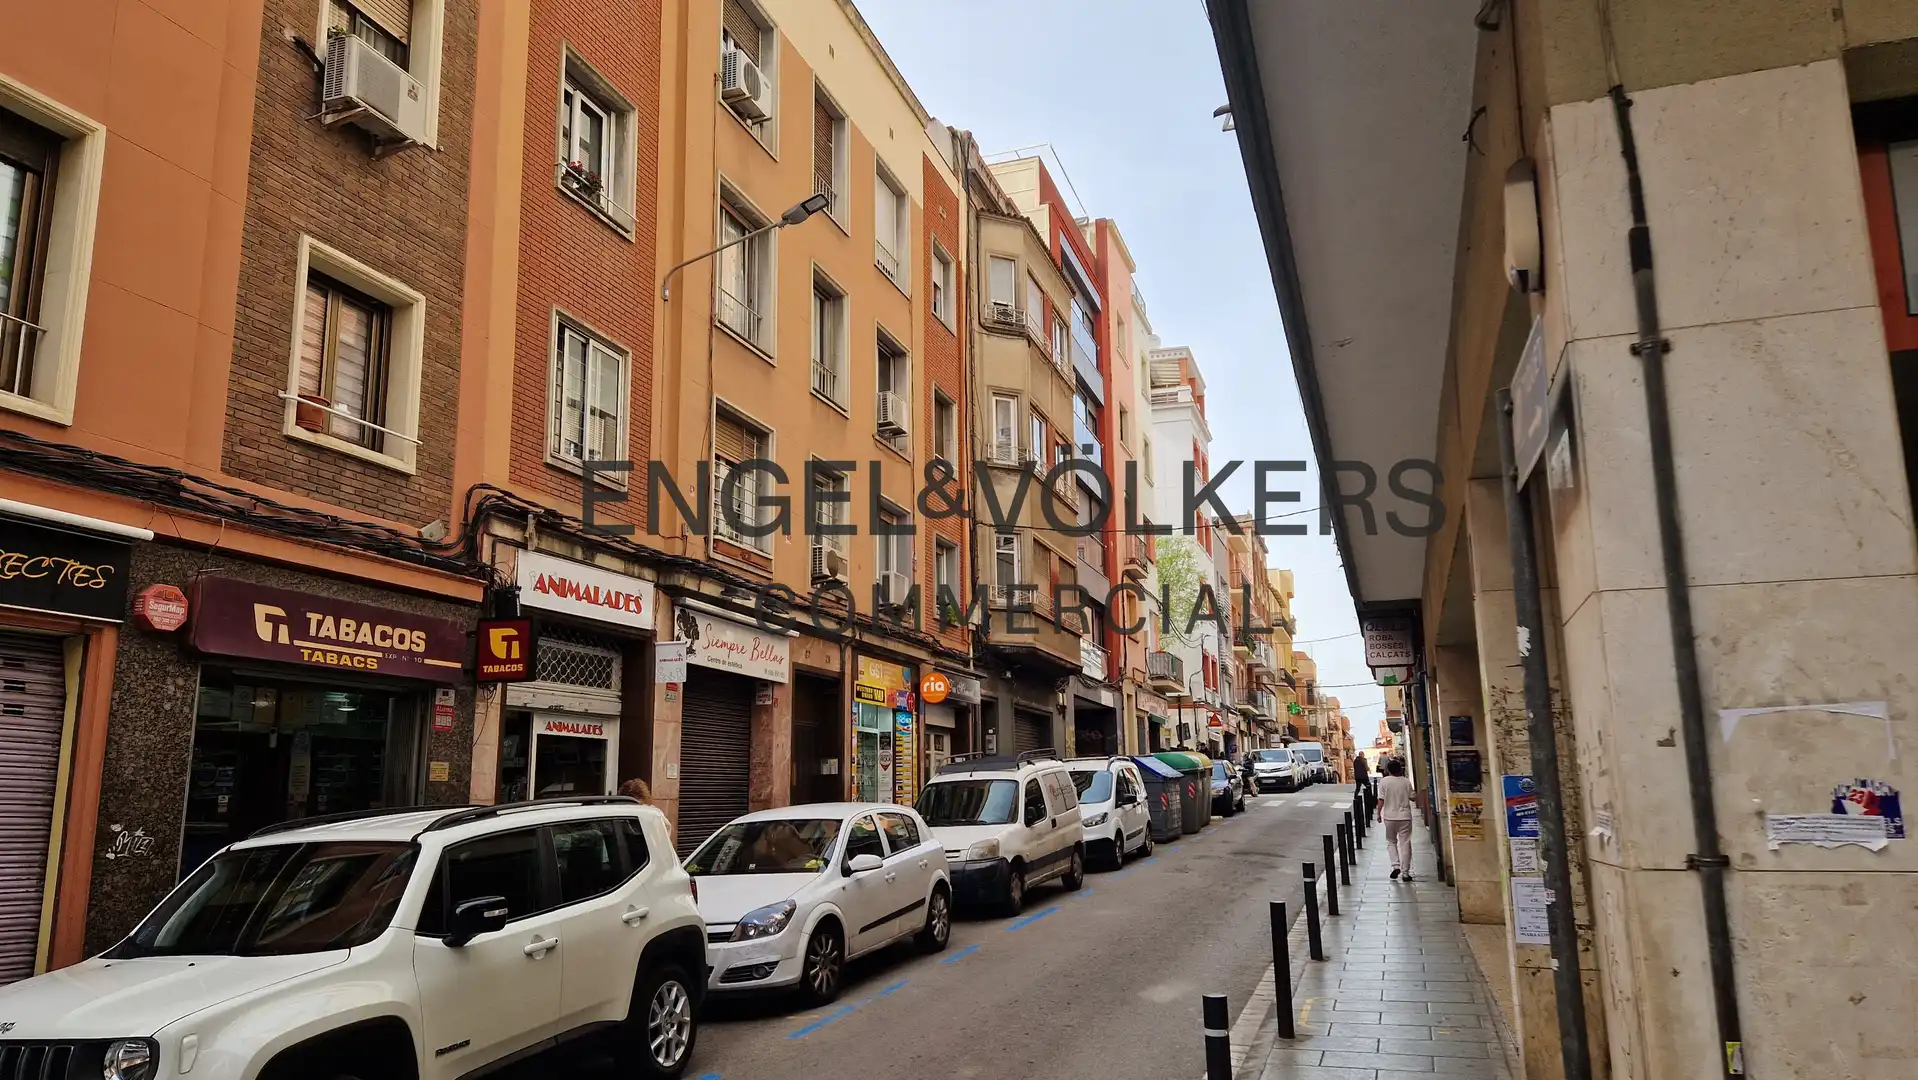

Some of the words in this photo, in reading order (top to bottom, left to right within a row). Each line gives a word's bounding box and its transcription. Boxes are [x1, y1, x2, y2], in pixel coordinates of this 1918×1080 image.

[533, 573, 642, 614] ANIMALADES
[306, 612, 426, 652] TABACOS
[702, 622, 747, 659] Siempre
[1369, 642, 1404, 650] BOSSES
[300, 649, 378, 669] TABACS
[1370, 651, 1411, 659] CALÇATS
[483, 664, 523, 673] TABACOS
[923, 676, 945, 693] ria
[545, 720, 603, 735] ANIMALADES
